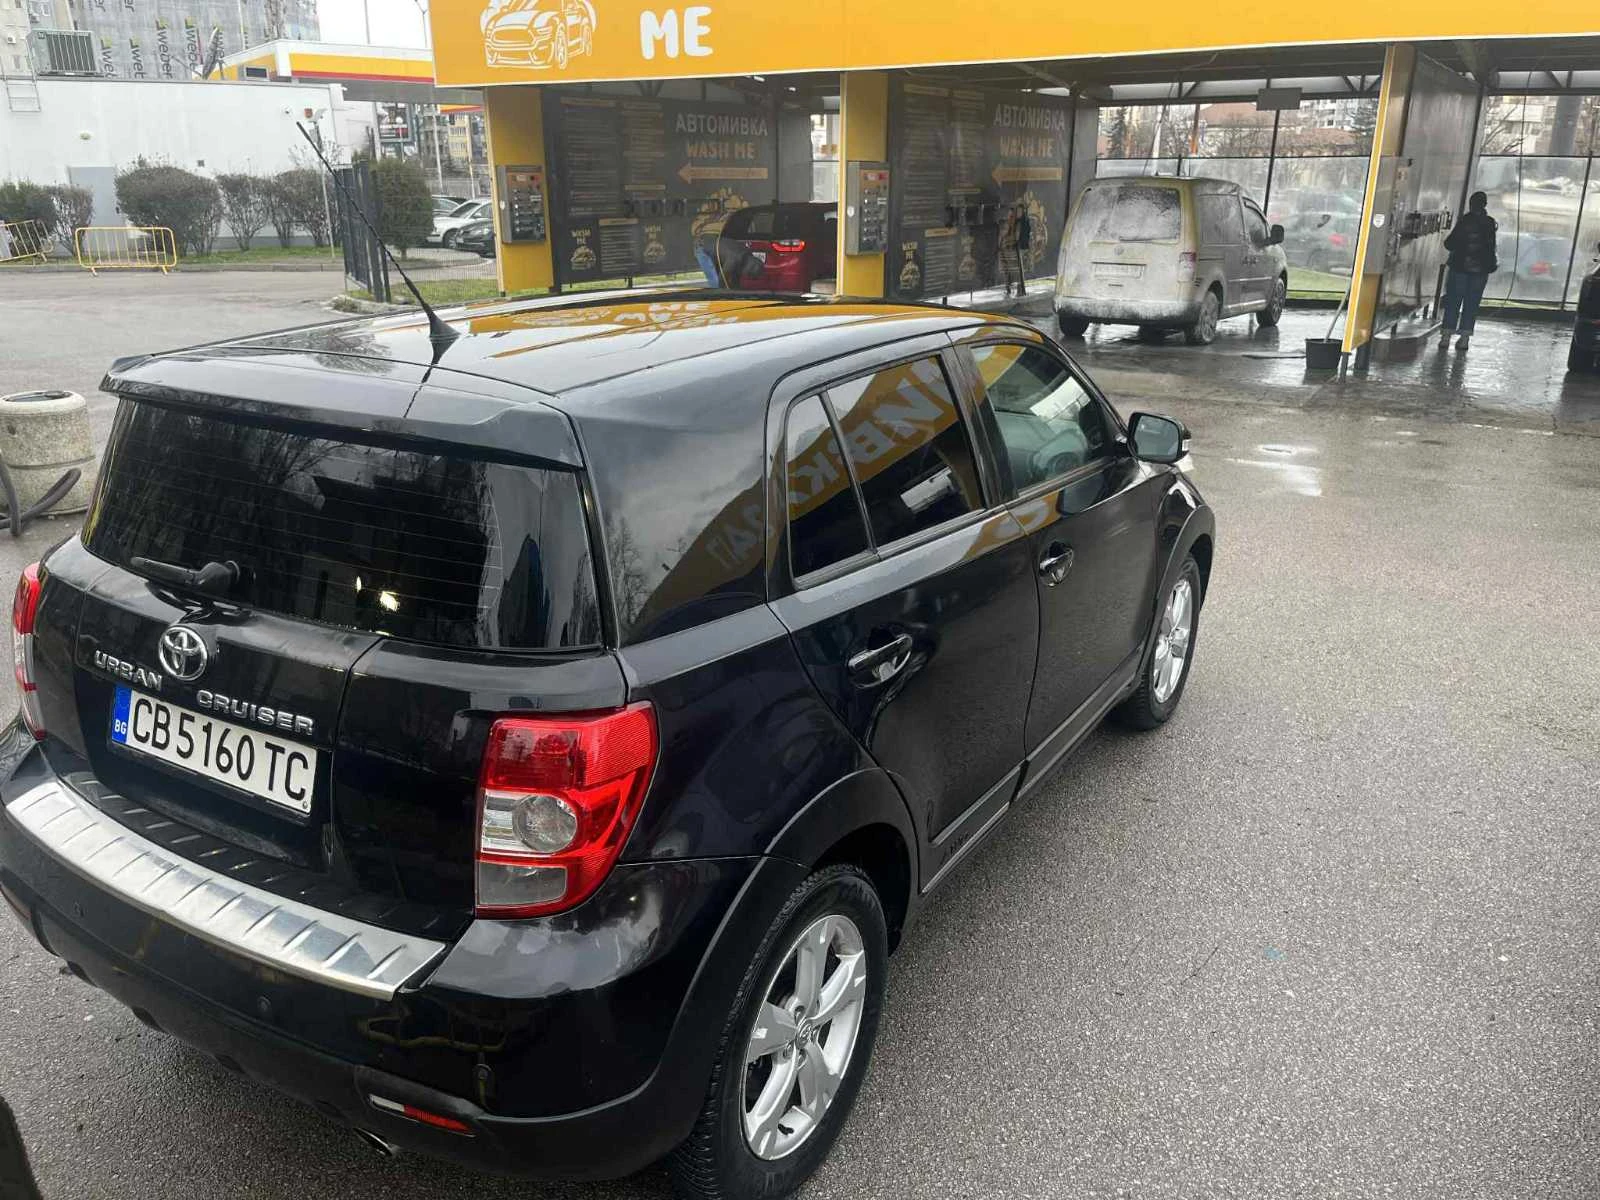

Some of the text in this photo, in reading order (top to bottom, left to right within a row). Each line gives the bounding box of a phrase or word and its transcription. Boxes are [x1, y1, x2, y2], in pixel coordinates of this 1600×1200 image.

[640, 6, 713, 60] ME
[676, 113, 768, 137] АВТОМИВКА
[993, 104, 1064, 130] АВТОМИВКА
[687, 143, 729, 160] WASH
[94, 650, 162, 691] URBAN
[196, 690, 314, 735] CRUISER
[114, 720, 127, 735] BG
